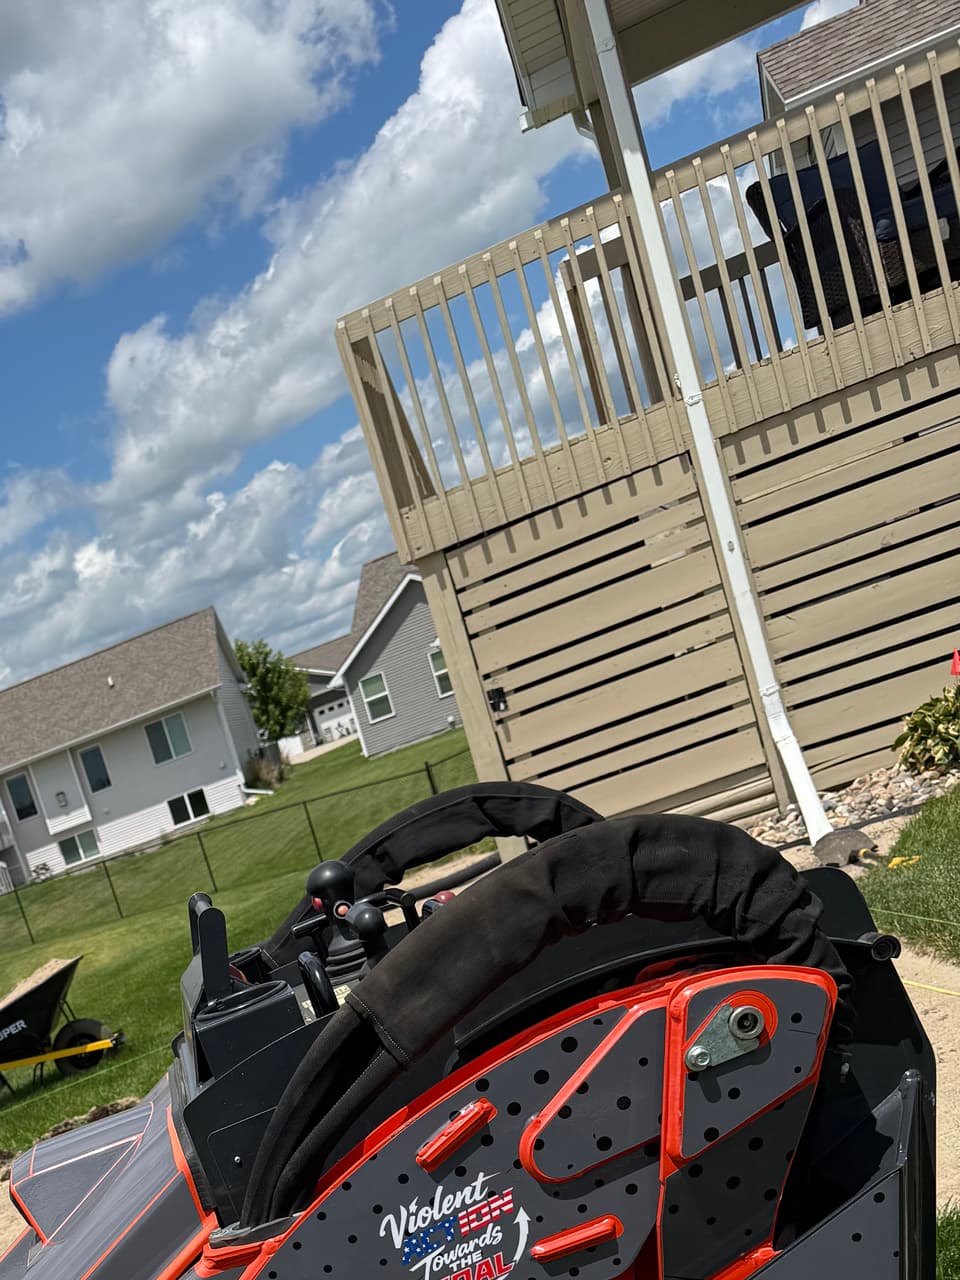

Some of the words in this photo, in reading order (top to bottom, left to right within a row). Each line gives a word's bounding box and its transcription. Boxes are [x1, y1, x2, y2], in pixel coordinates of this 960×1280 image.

[379, 1172, 501, 1249] Violent
[401, 1187, 514, 1266] ACTION
[449, 1250, 482, 1272] THE
